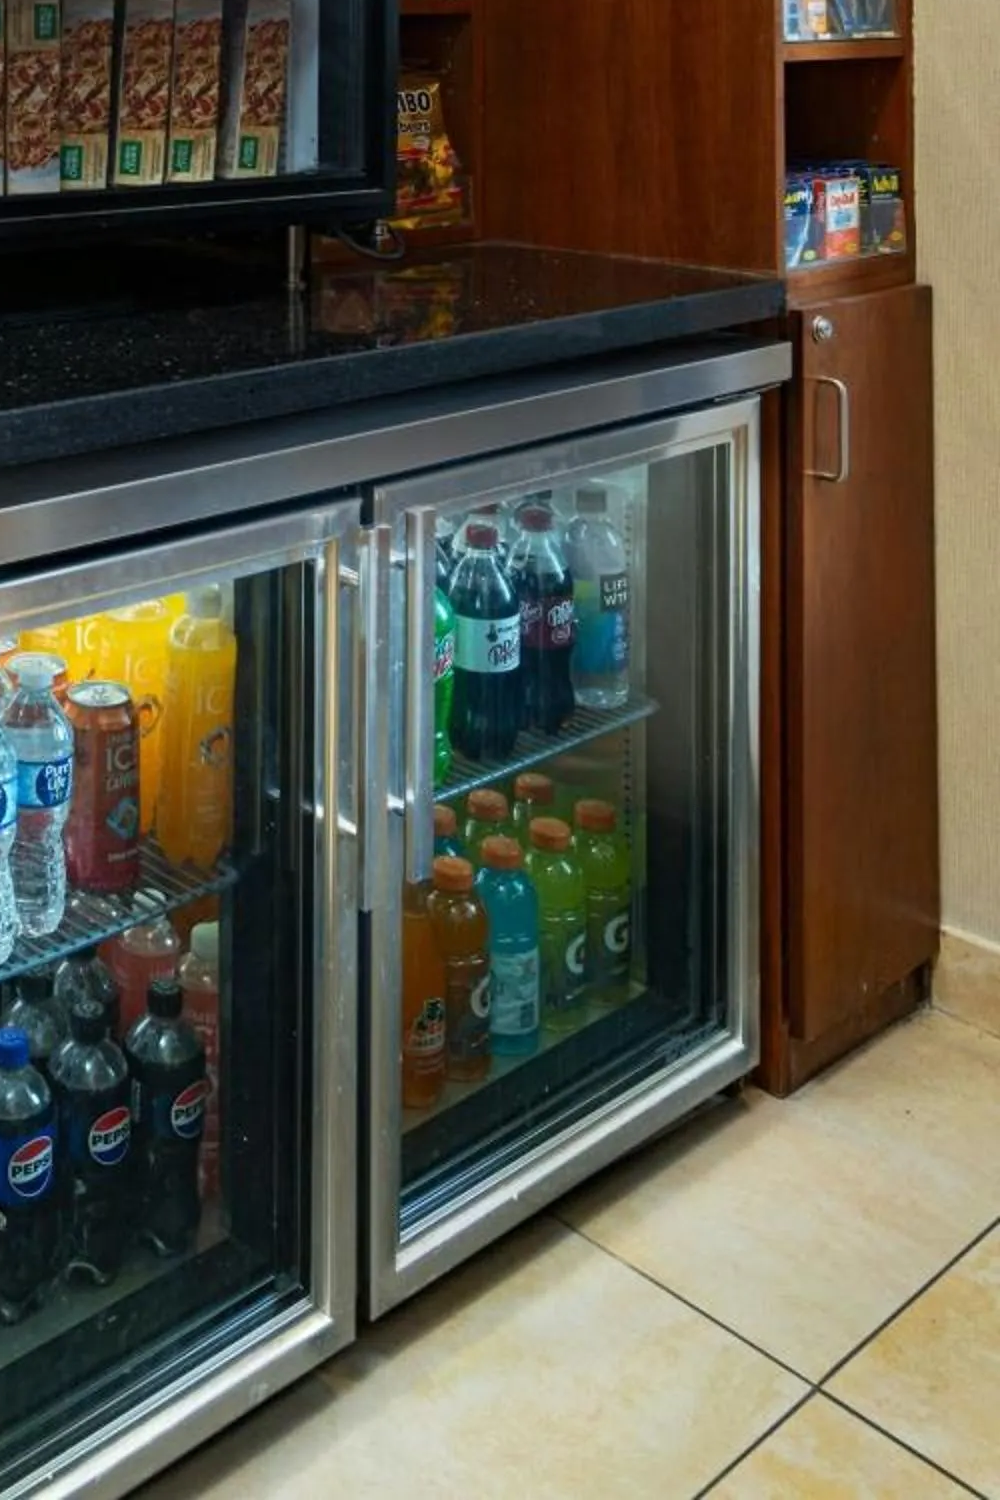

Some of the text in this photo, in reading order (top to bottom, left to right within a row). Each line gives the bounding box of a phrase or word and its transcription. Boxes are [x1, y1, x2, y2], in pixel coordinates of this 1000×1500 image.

[603, 579, 627, 593] LIF
[174, 1103, 202, 1121] PEP
[91, 1124, 131, 1146] PEPS
[11, 1151, 52, 1179] PEPS
